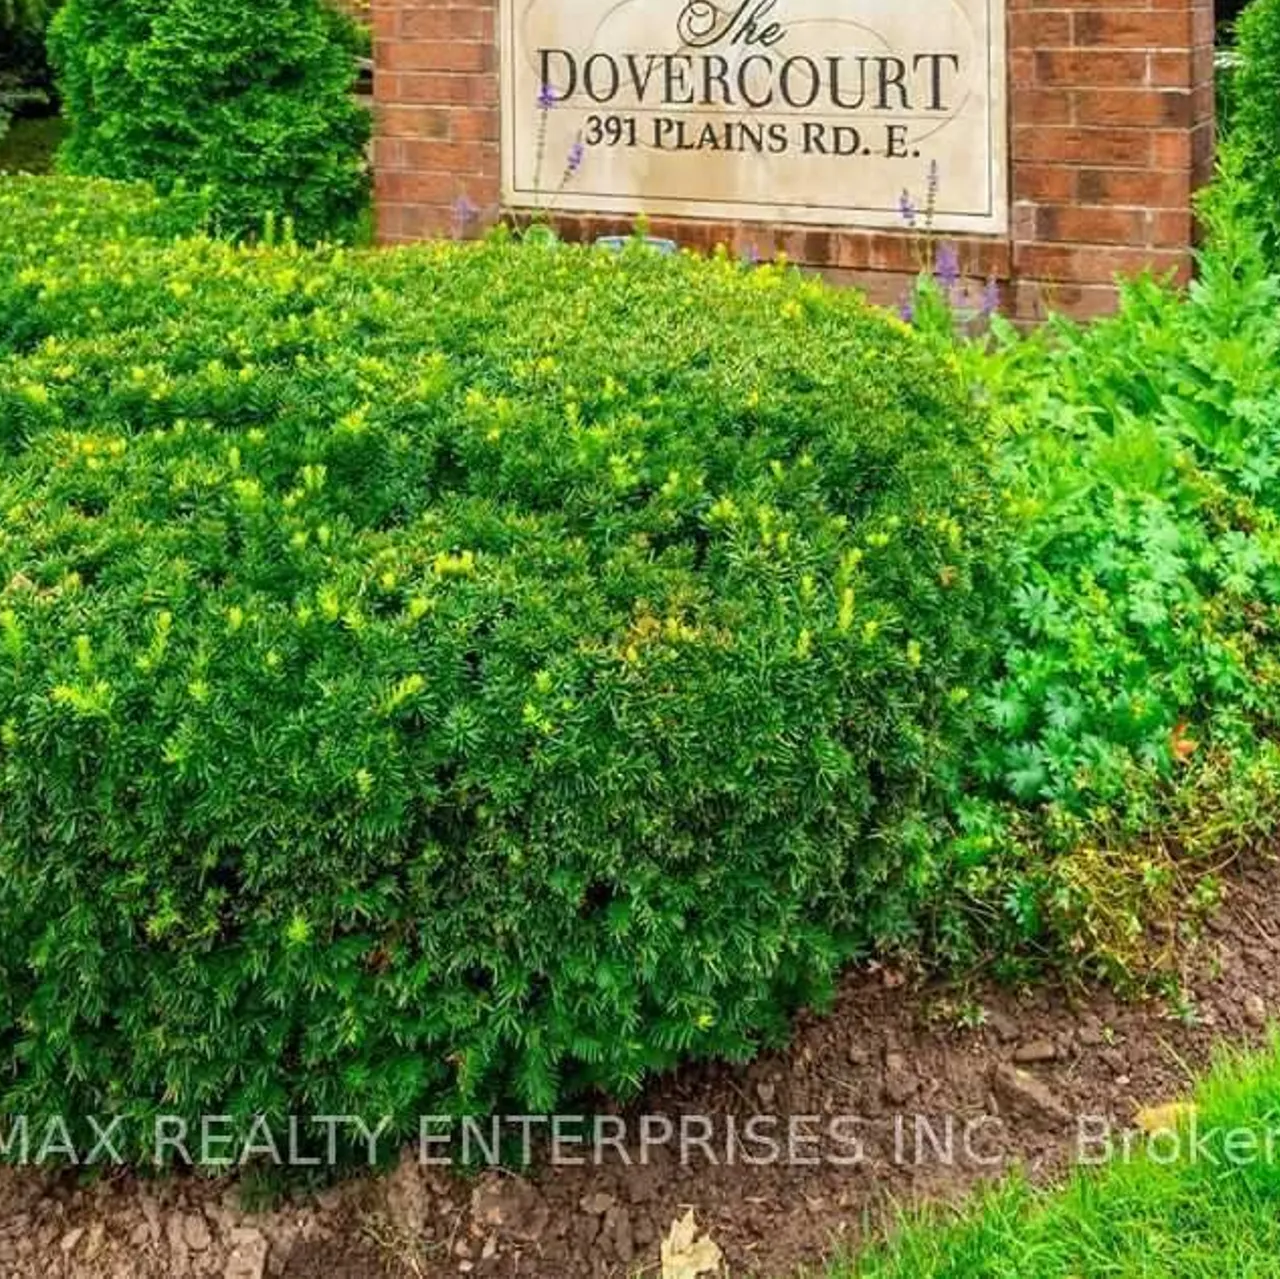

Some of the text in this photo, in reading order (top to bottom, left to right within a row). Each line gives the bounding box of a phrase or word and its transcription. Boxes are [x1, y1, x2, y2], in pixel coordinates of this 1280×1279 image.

[536, 48, 960, 112] DOVERCOURT
[584, 115, 922, 158] 391 PLAINS RD. E.
